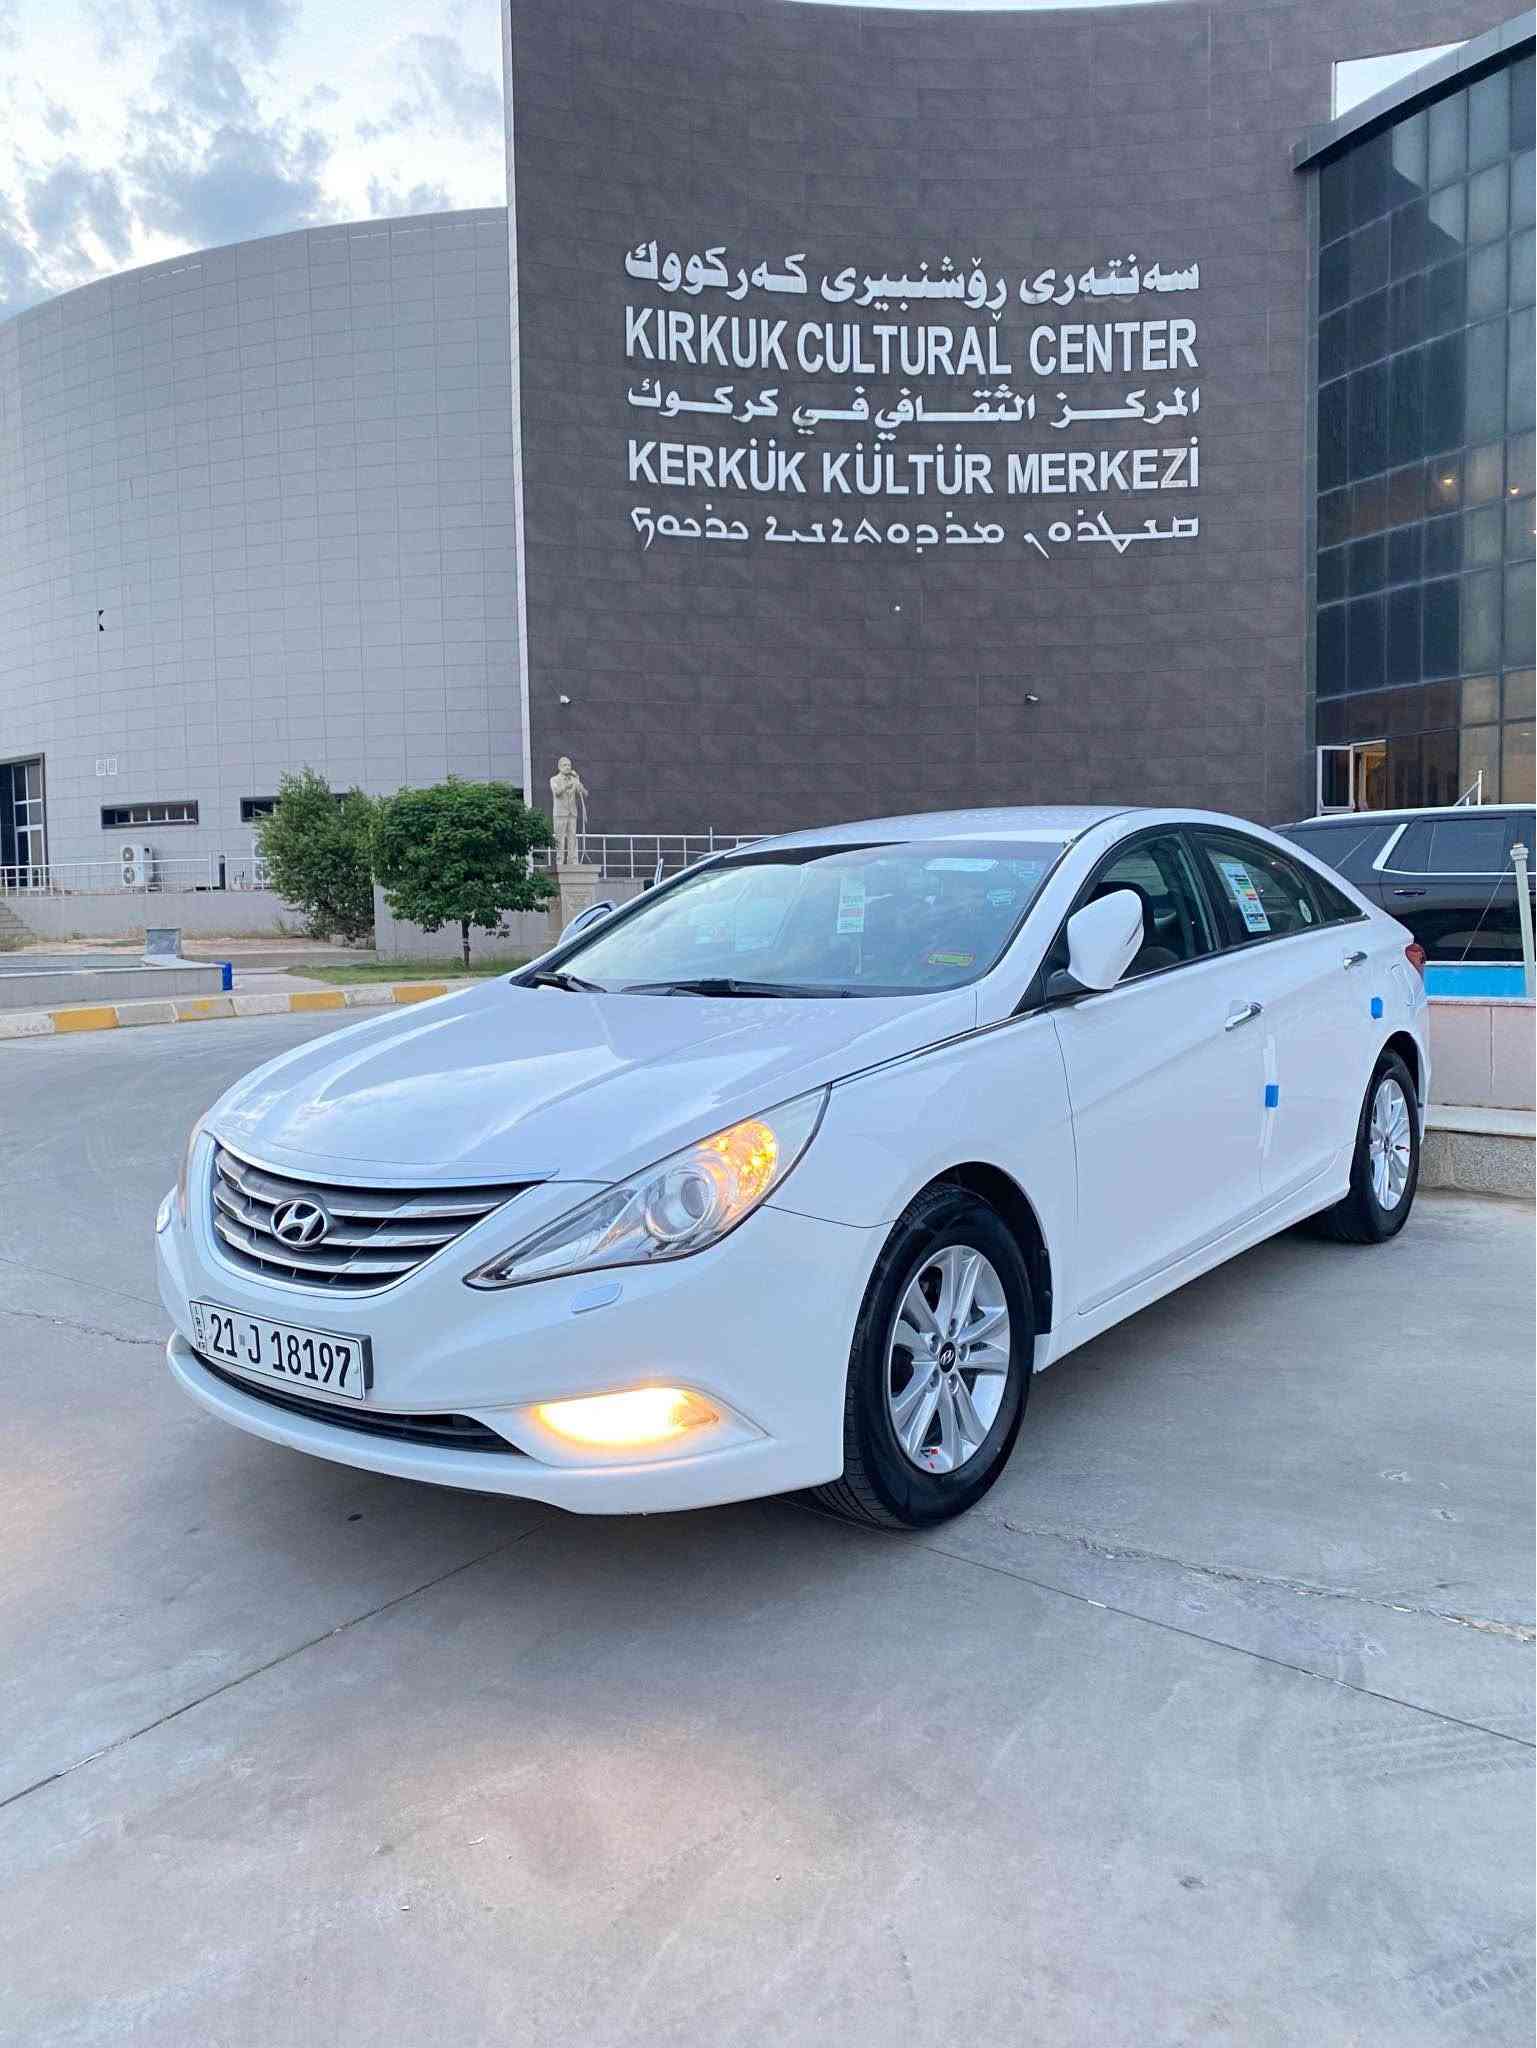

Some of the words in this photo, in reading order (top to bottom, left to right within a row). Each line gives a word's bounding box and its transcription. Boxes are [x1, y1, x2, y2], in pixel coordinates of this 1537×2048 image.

[625, 305, 789, 370] KIRKUK
[797, 322, 1012, 375] CULTURAL
[1029, 318, 1199, 376] CENTER
[628, 378, 779, 423] كركوك
[792, 385, 869, 435] في
[875, 383, 1036, 440] الثقافي
[1050, 386, 1200, 428] المركز
[628, 438, 807, 494] KERKÜK
[822, 442, 994, 496] KÜLTÜR
[1007, 436, 1199, 494] MERKEZİ
[211, 1313, 238, 1358] 21
[248, 1324, 261, 1364] J
[271, 1331, 351, 1387] 18197
